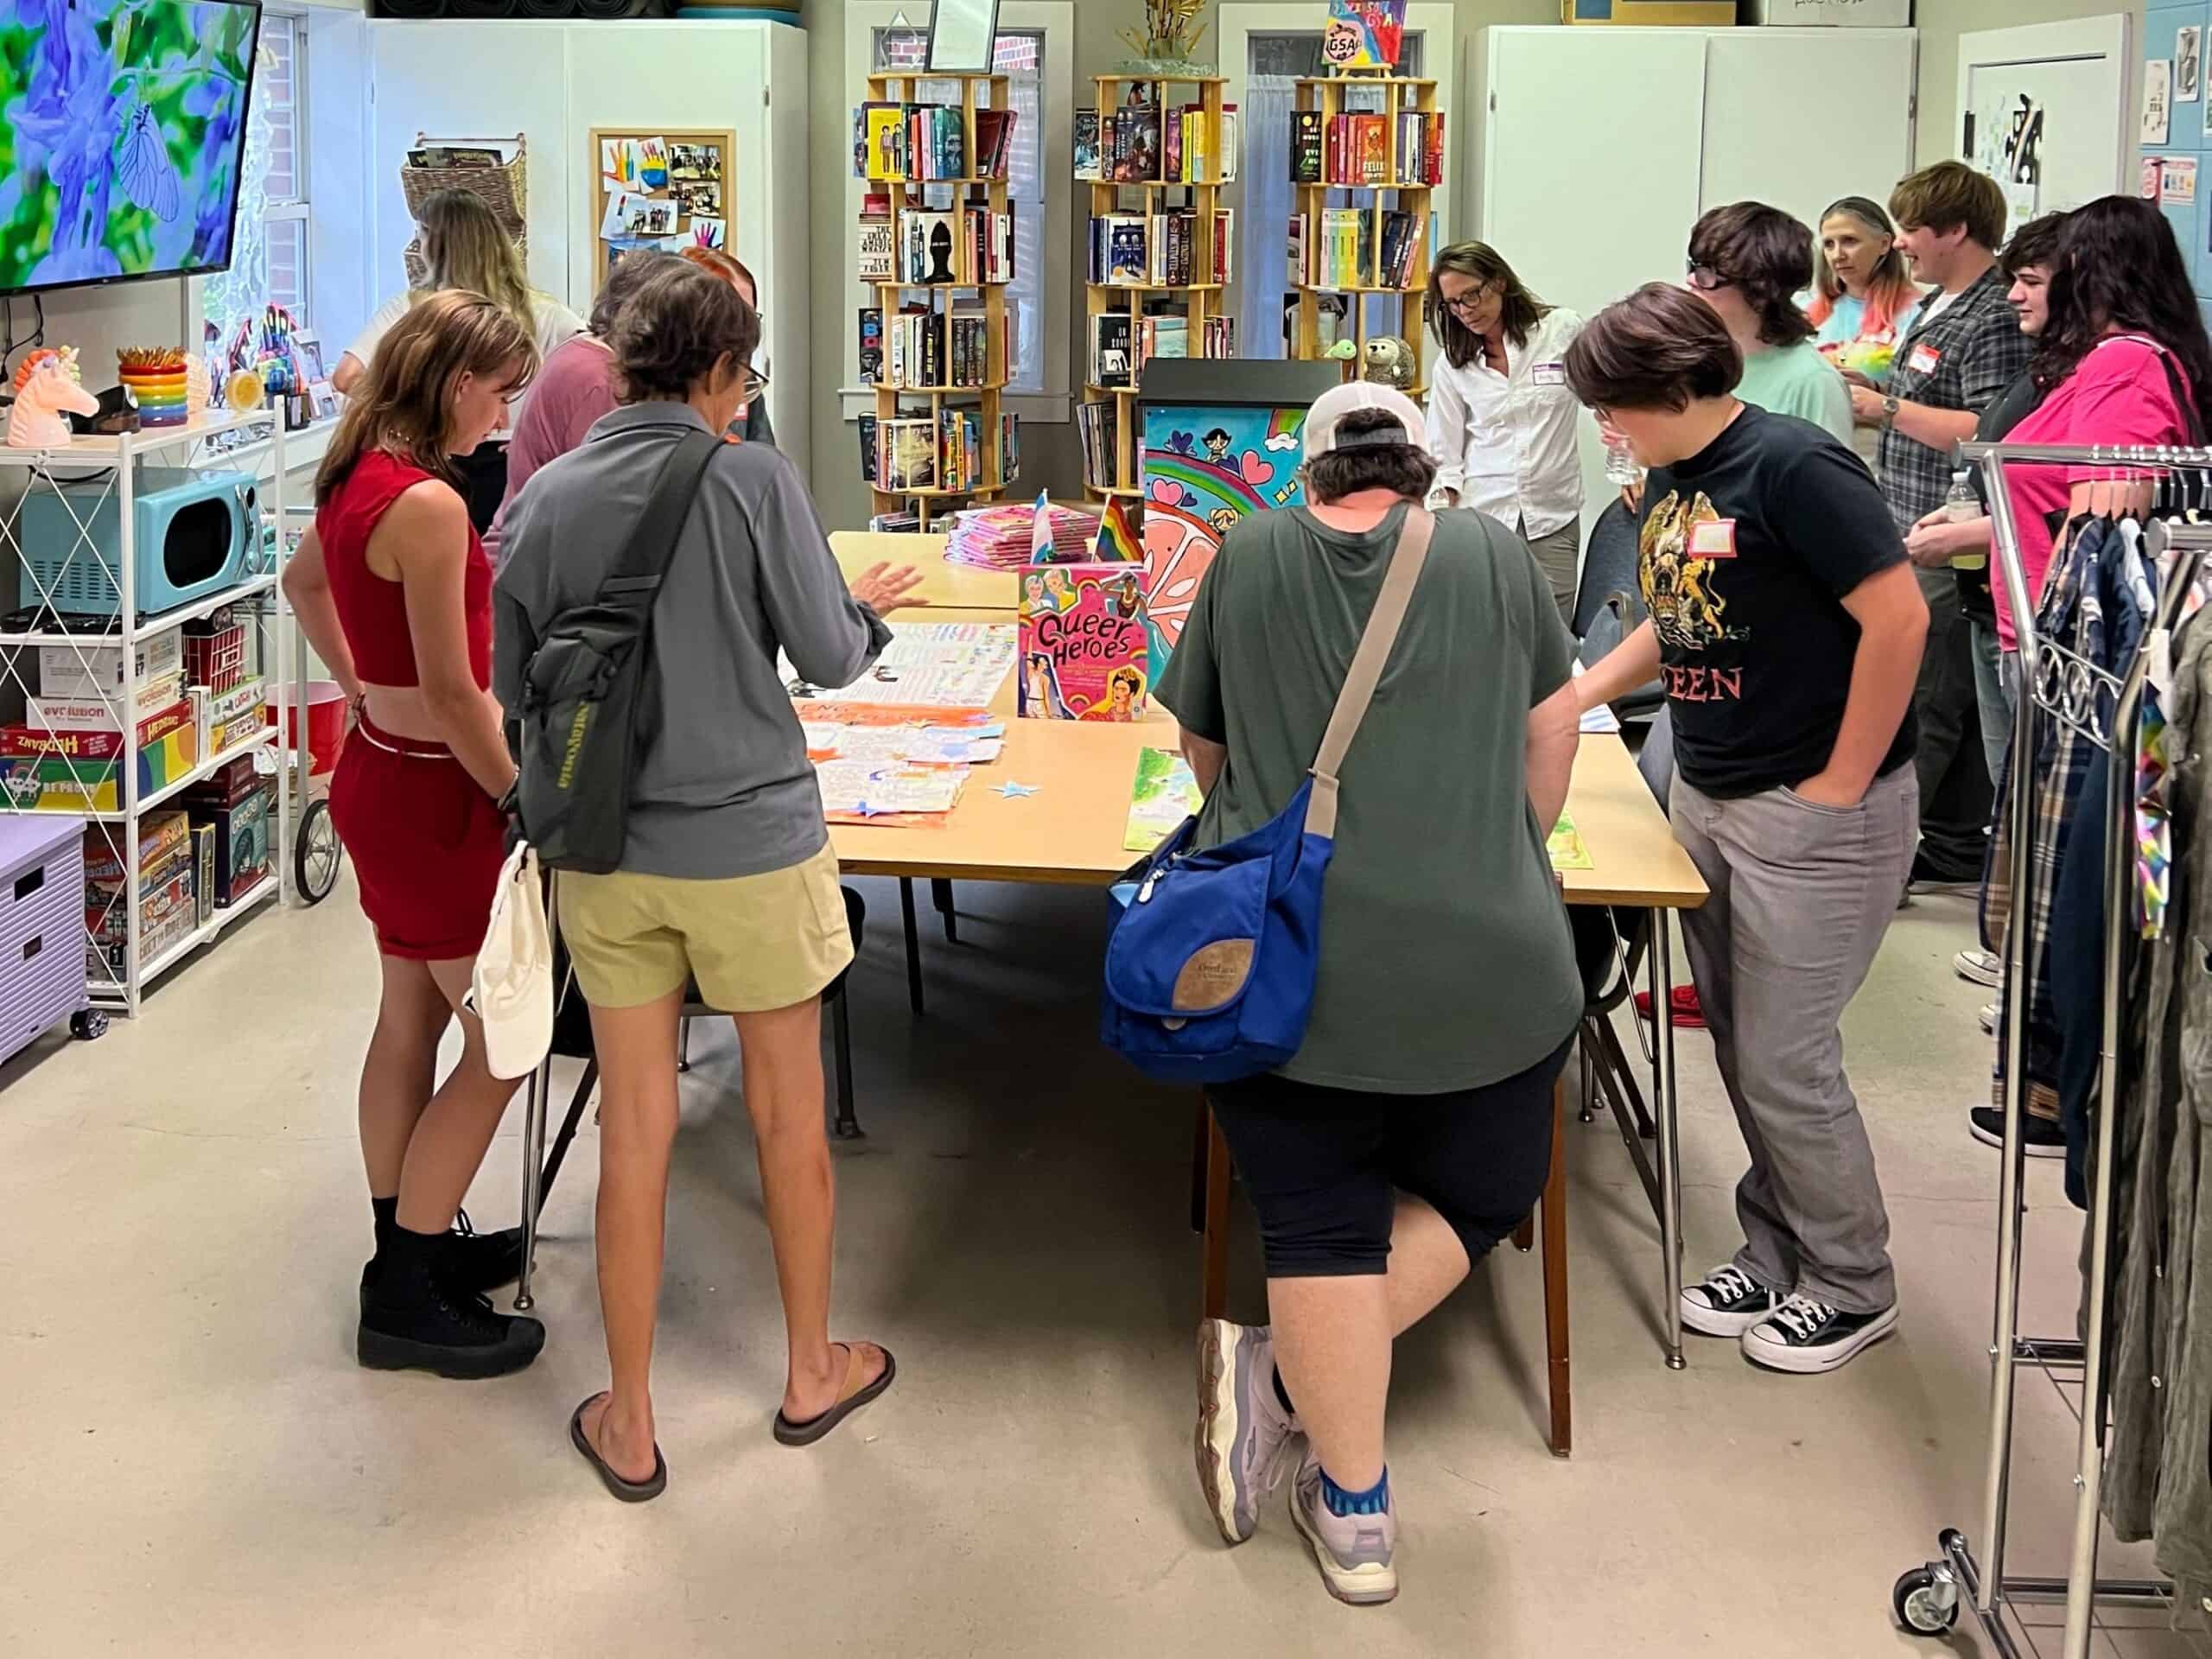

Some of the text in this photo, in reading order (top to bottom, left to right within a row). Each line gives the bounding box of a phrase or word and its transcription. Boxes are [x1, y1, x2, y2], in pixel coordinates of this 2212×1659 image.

[1330, 38, 1356, 51] GSA
[1039, 613, 1134, 647] Queer
[1052, 635, 1131, 669] Heroes
